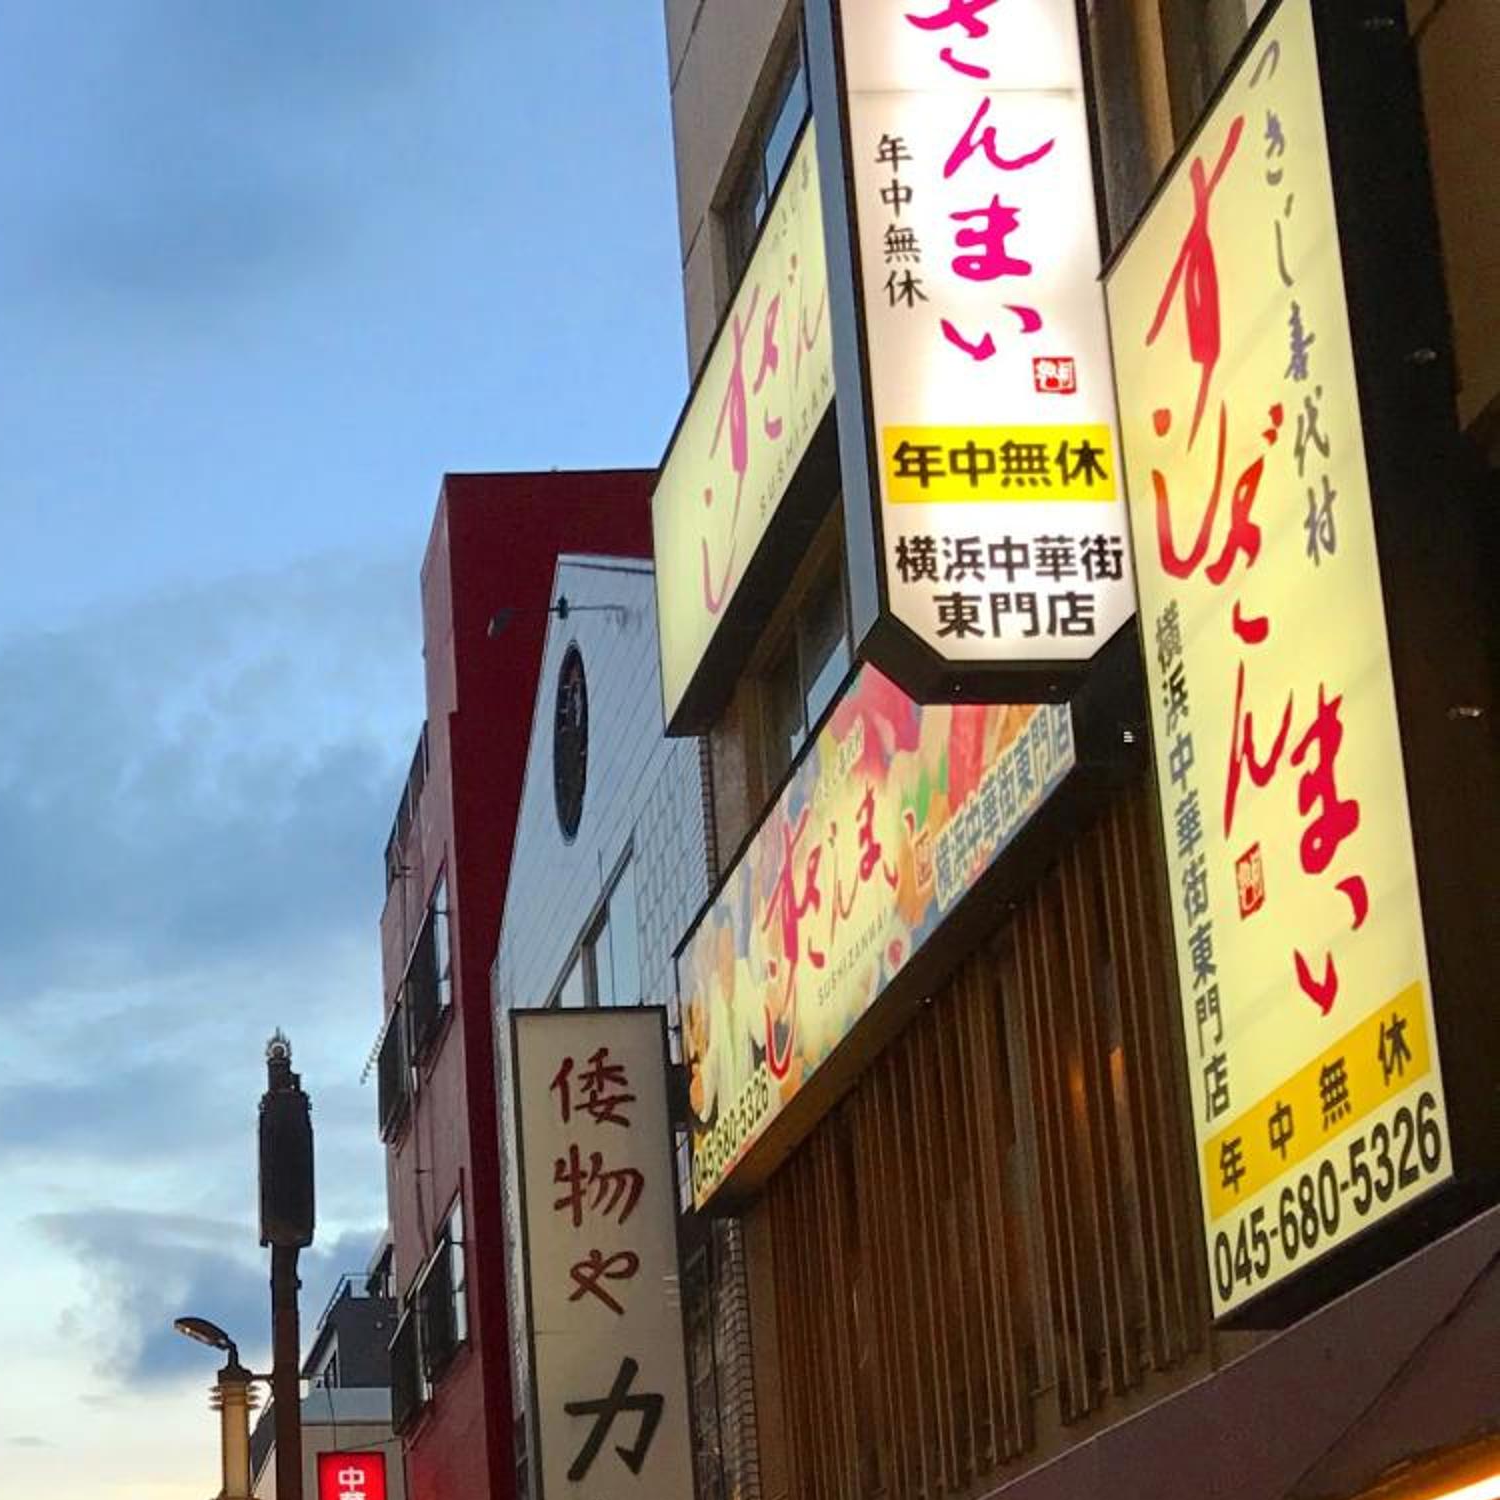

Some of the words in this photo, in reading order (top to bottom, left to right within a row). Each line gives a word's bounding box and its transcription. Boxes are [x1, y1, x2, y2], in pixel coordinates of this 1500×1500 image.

[874, 133, 930, 309] 年中無休
[892, 440, 1109, 490] 年中無休
[894, 535, 1125, 585] 横浜中華街
[934, 590, 1097, 640] 東門店
[1154, 598, 1232, 1125] 横浜中華街東門店
[692, 1068, 771, 1196] 045-680-5326
[1217, 1008, 1414, 1196] 年中無休
[1213, 1090, 1443, 1303] 045-680-5326
